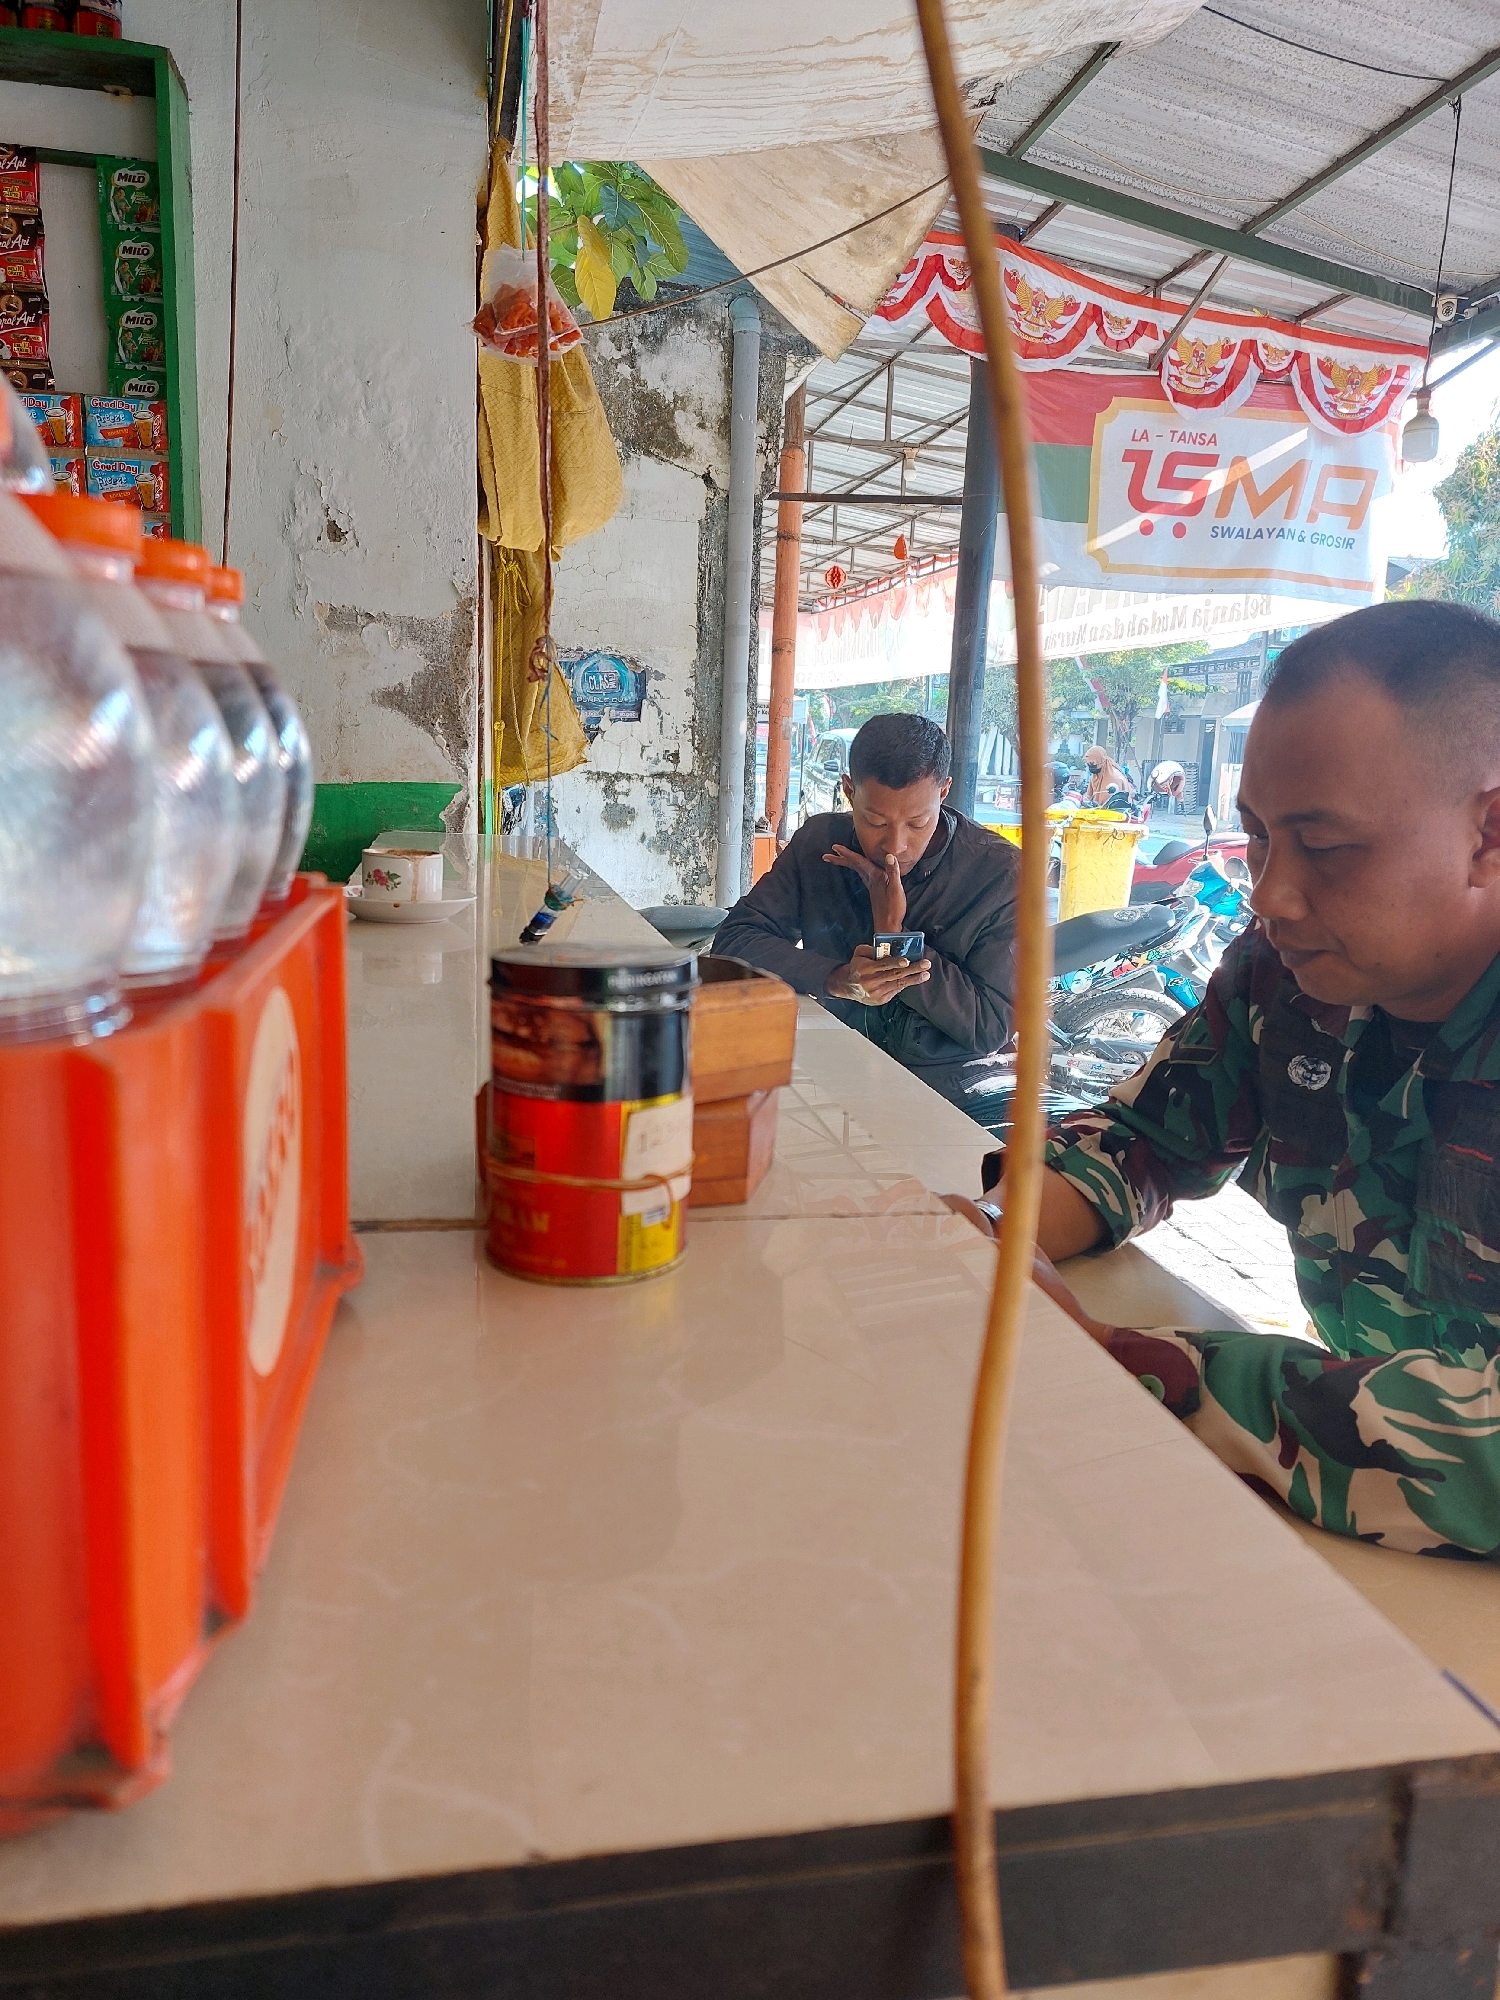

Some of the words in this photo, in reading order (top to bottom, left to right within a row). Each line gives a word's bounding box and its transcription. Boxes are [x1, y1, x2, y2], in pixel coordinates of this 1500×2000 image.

[117, 172, 146, 184] MILO
[11, 233, 31, 250] Api
[122, 245, 150, 256] MILO
[16, 310, 36, 327] Api
[125, 315, 154, 326] MILO
[128, 383, 155, 394] MILO
[28, 397, 48, 409] Day
[91, 398, 116, 409] Good
[117, 400, 137, 413] Day
[1131, 428, 1150, 442] LA
[1169, 430, 1218, 447] TANSA
[92, 459, 117, 471] Good
[119, 461, 139, 475] Day
[1210, 525, 1296, 541] SWALAYAN
[1297, 530, 1306, 543] &
[1310, 531, 1355, 550] GROSIR
